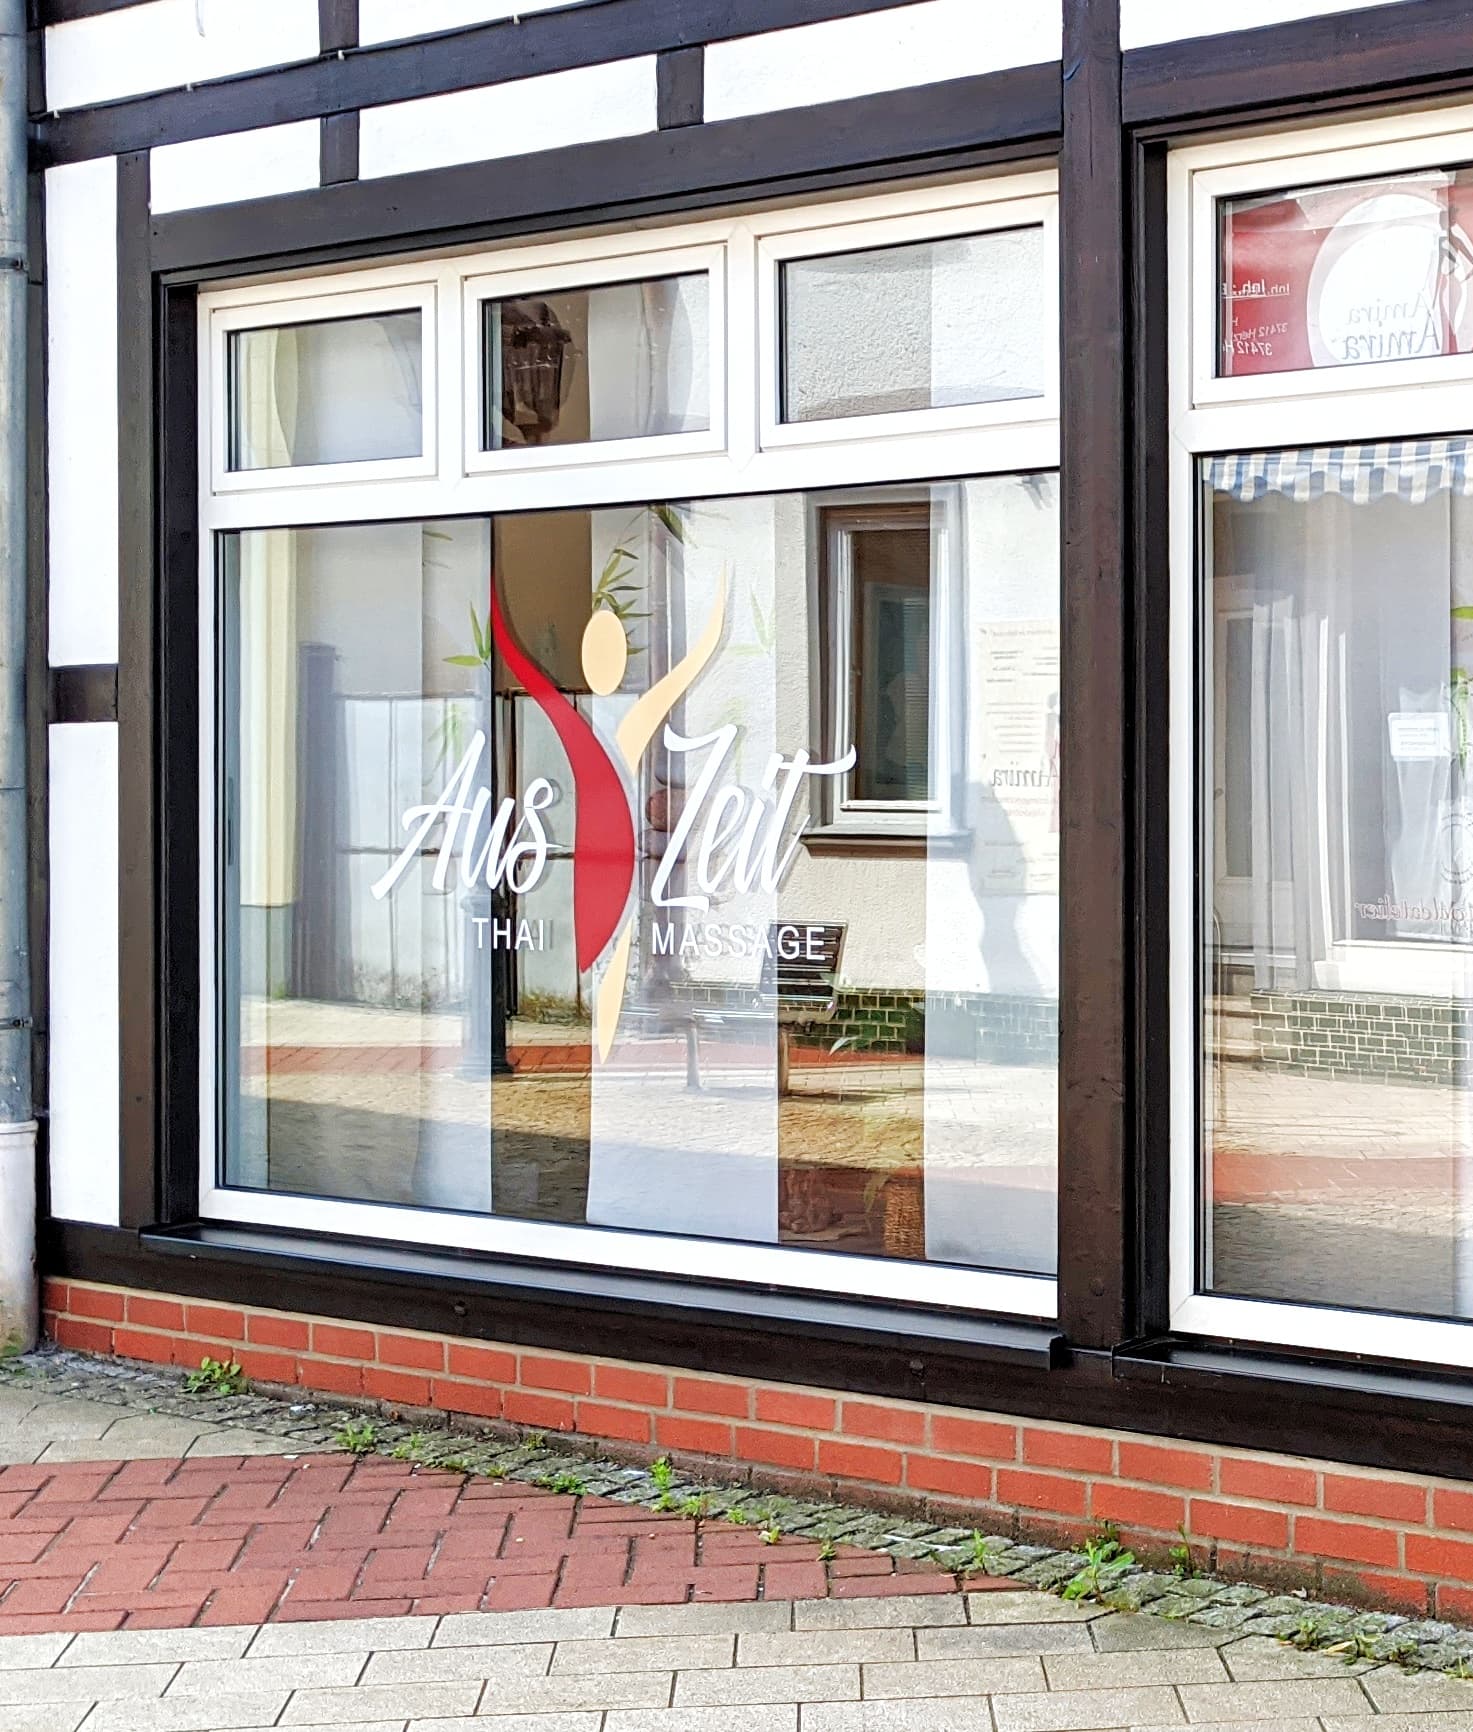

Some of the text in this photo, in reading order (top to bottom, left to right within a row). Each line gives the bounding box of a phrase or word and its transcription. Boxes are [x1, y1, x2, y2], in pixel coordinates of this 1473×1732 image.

[370, 723, 857, 912] Aus Zeit
[472, 917, 827, 962] THAI MASSAGE
